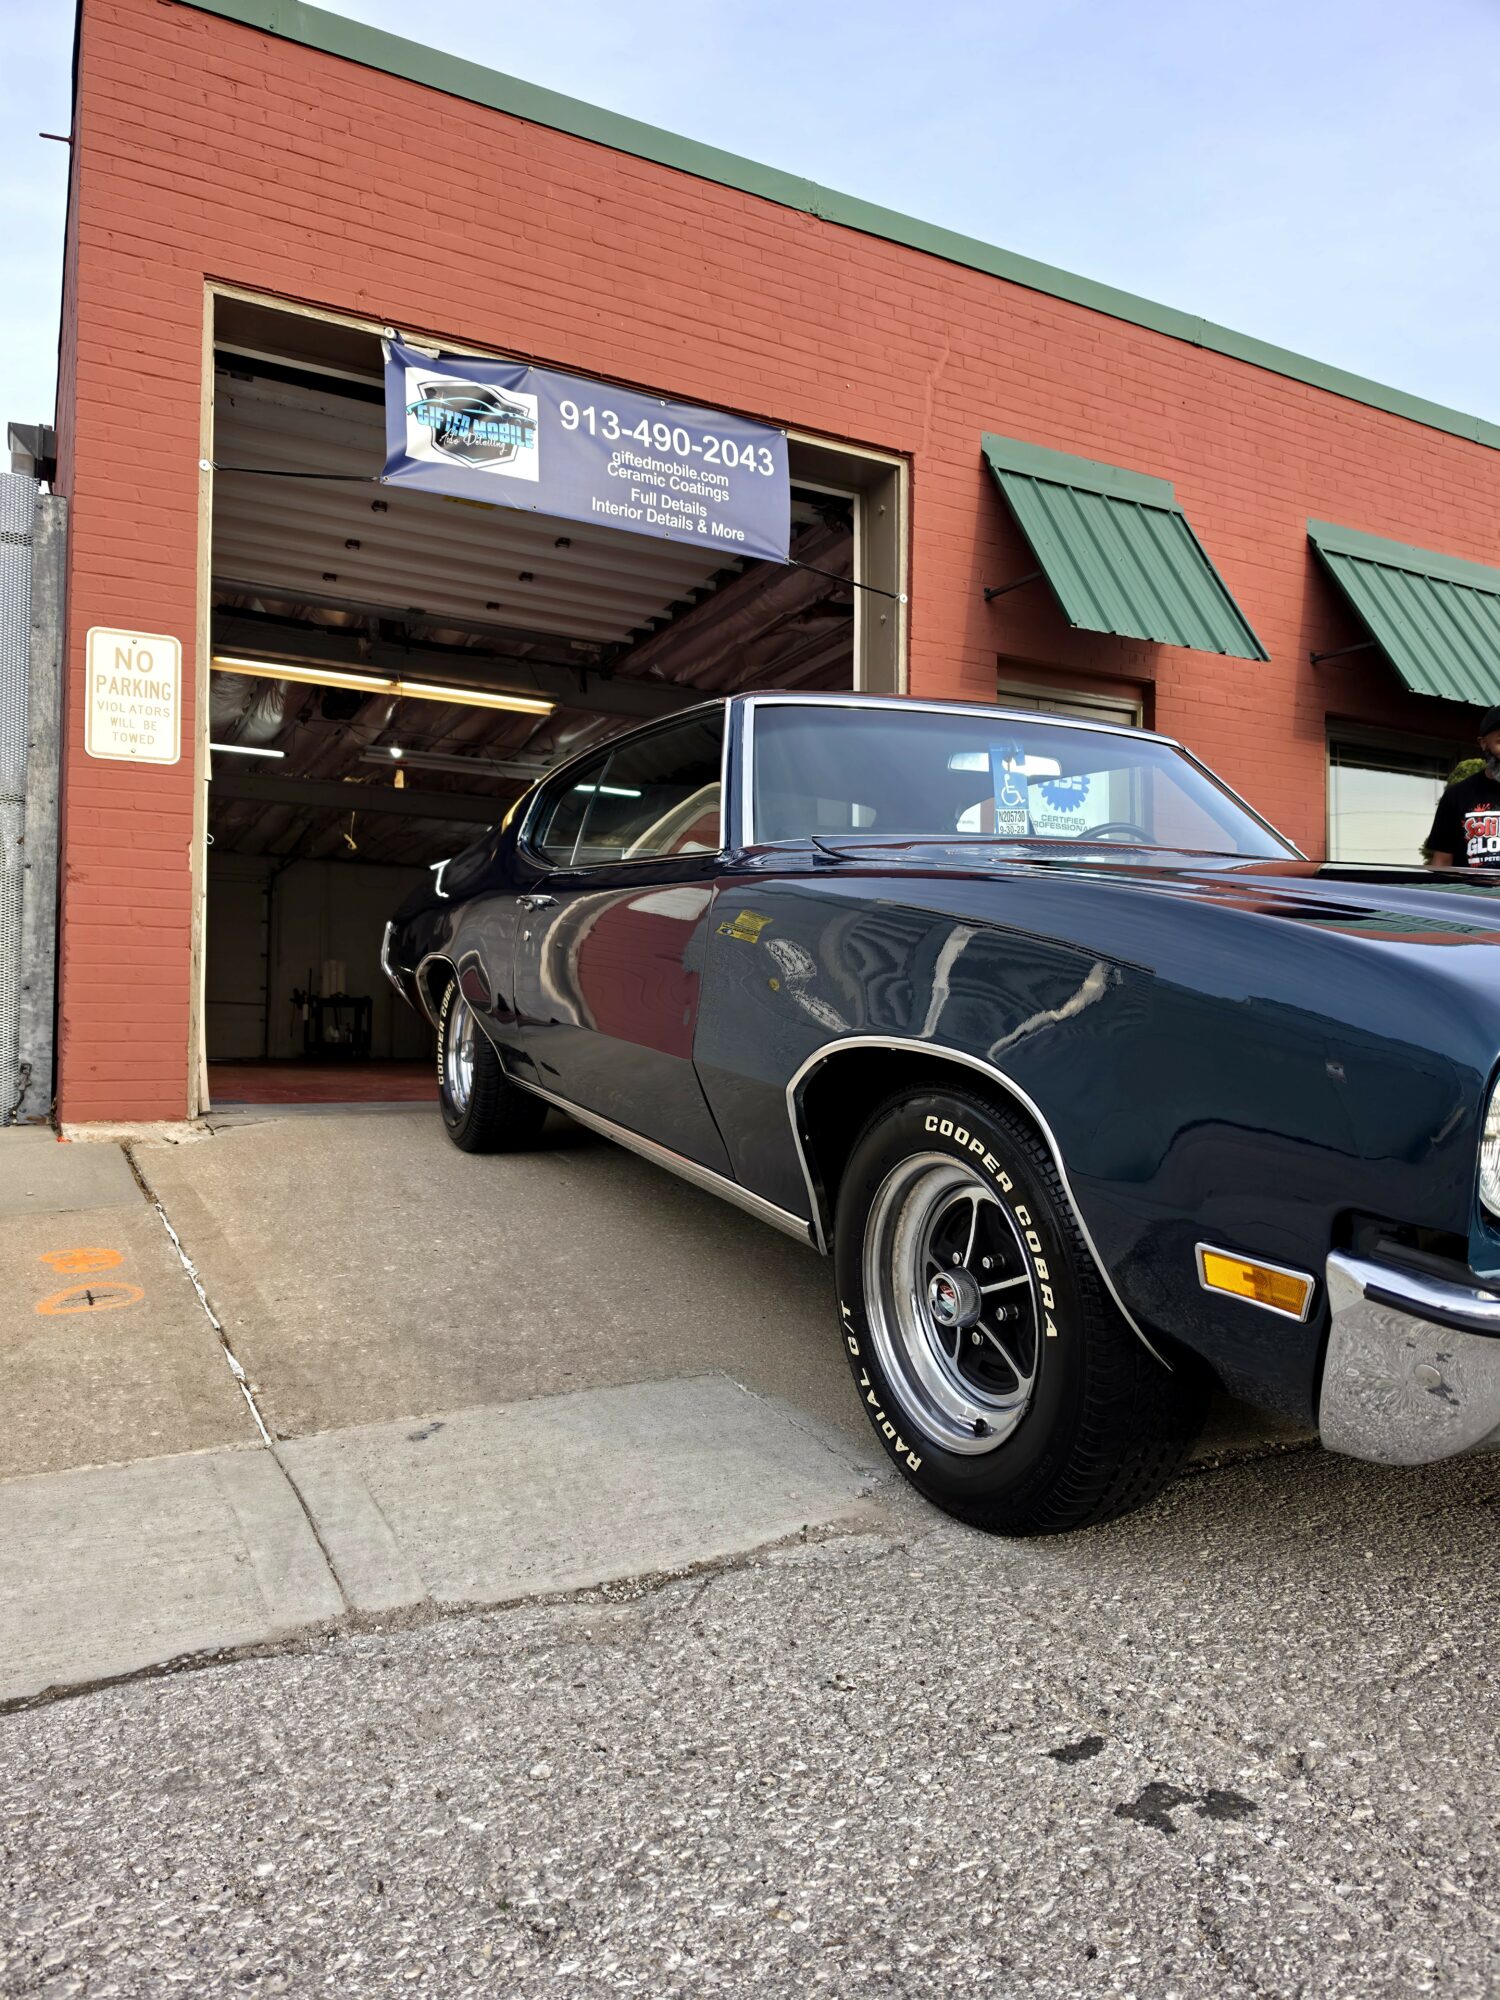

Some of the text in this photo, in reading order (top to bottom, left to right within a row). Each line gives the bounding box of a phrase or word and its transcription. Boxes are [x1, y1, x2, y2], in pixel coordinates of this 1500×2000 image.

[417, 404, 535, 449] GIFTED MOBILE
[559, 400, 775, 476] 913-490-2043
[607, 462, 730, 502] Ceramic Coatings
[612, 451, 729, 486] giftedmobile.com
[631, 488, 708, 517] Full Details
[591, 497, 745, 541] Interior Details & More
[115, 647, 154, 672] NO
[96, 675, 171, 701] PARKING
[97, 700, 170, 718] VIOLATORS
[110, 717, 157, 731] WILL BE
[112, 732, 155, 745] TOWED
[1032, 820, 1091, 832] ROFESSIONA
[1041, 814, 1086, 825] CERTIFIED
[437, 979, 456, 1086] COOPER COBRA
[925, 1115, 1058, 1337] COOPER COBRA
[840, 1300, 922, 1472] RADIAL G/T
